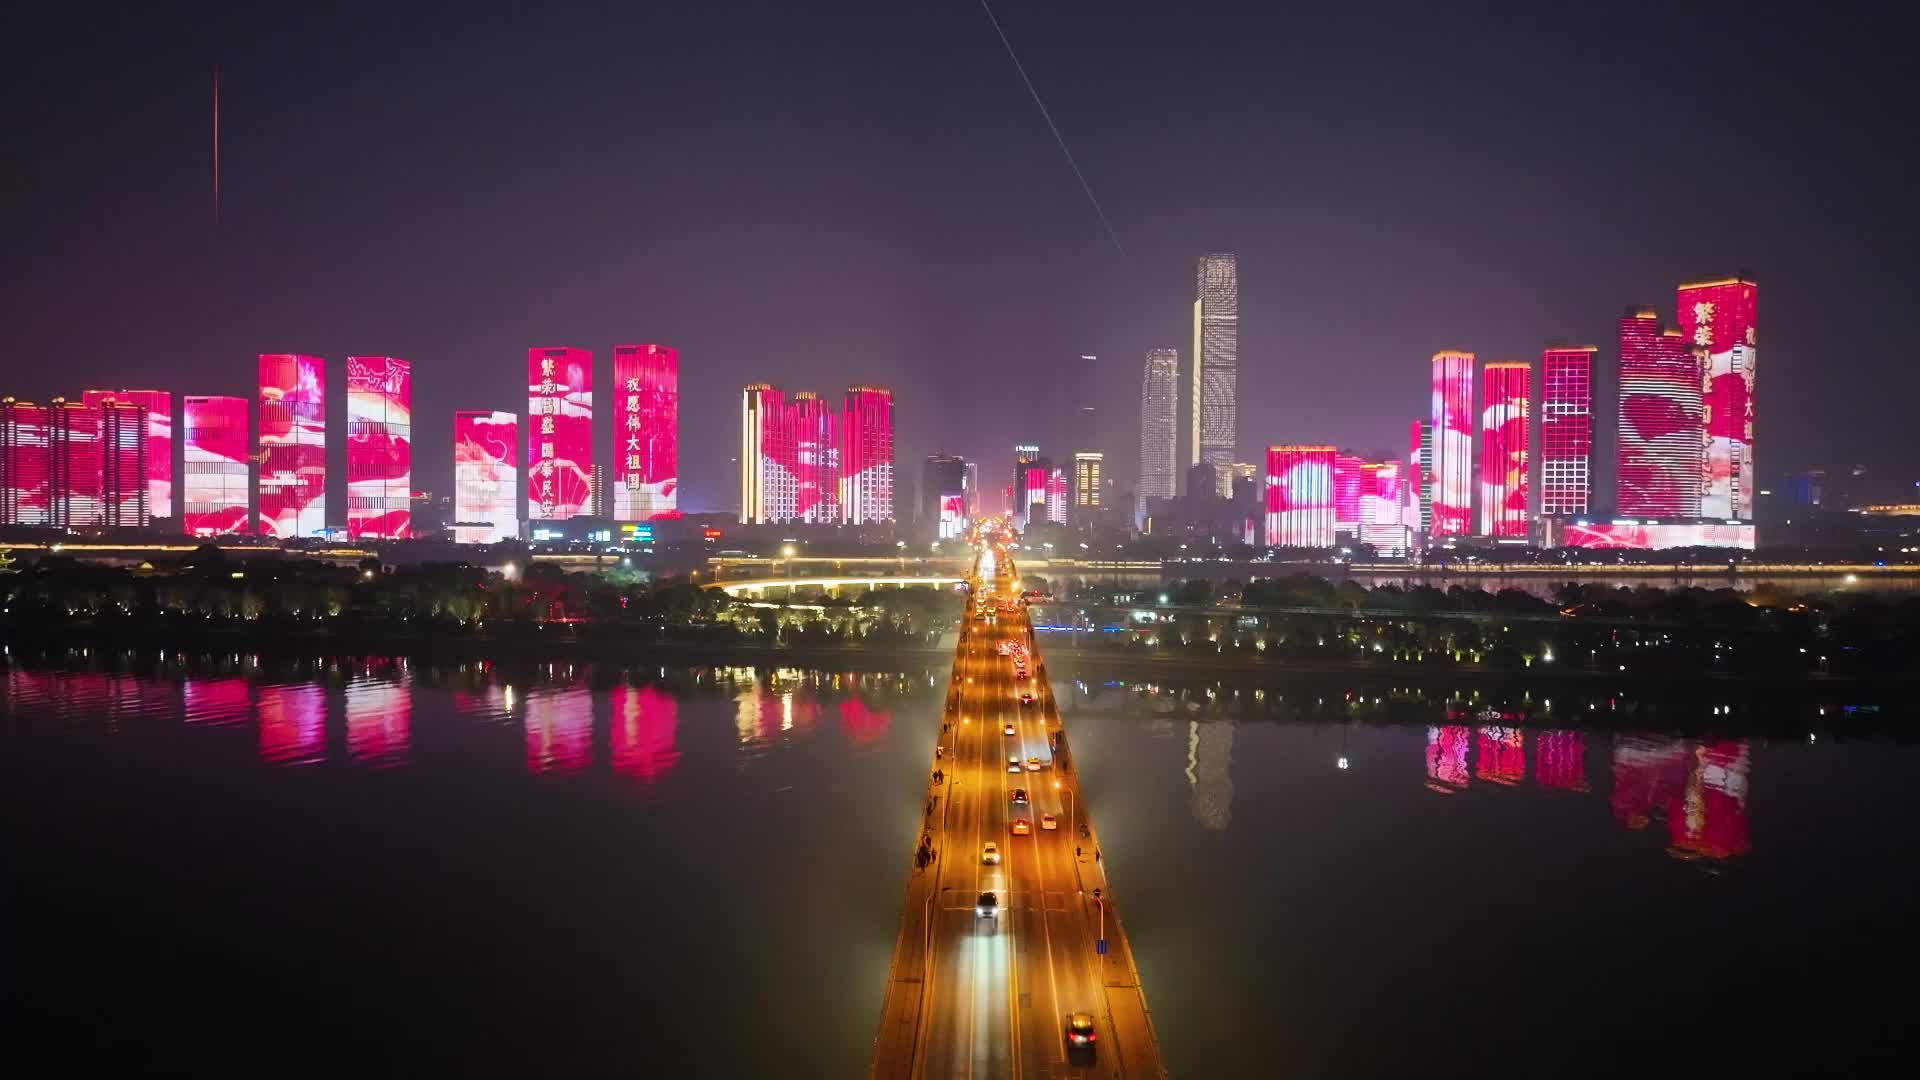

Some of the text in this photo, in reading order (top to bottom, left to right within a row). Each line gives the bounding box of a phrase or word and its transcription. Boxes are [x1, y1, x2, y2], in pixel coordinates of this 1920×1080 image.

[625, 376, 642, 492] 祝愿伟大祖国
